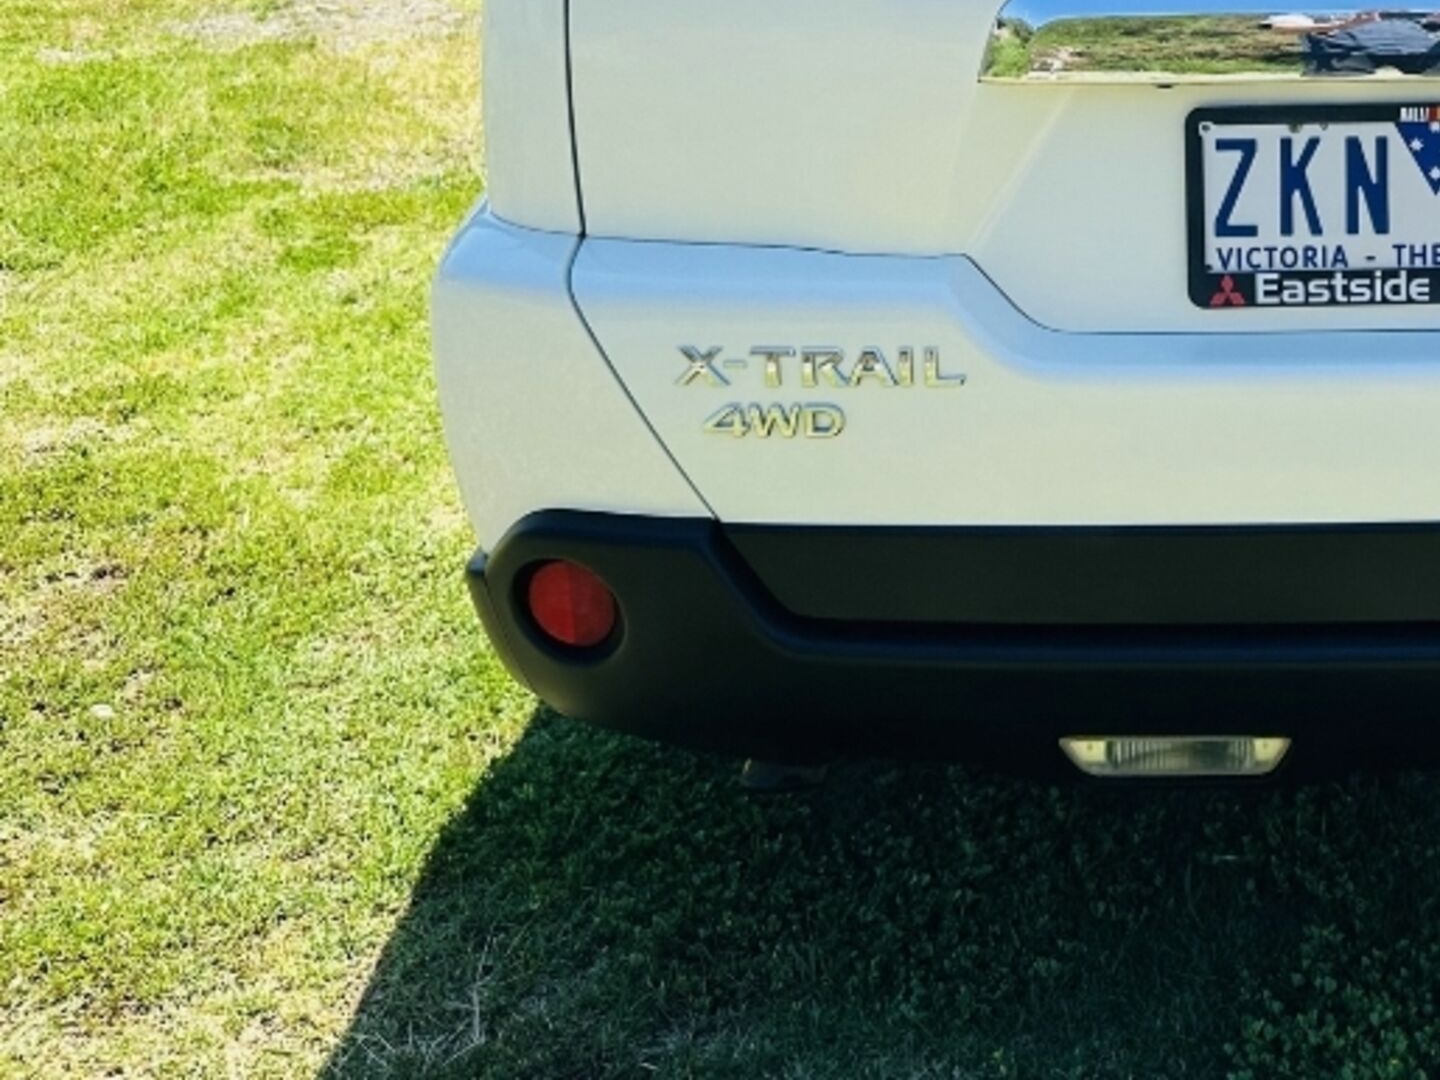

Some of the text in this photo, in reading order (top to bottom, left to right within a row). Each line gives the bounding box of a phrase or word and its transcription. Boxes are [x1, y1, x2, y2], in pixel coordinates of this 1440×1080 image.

[1214, 136, 1390, 238] ZKN
[1216, 245, 1349, 270] VICTORIA
[1255, 271, 1431, 304] Eastside
[675, 345, 967, 387] X-TRAIL
[703, 402, 847, 438] 4WD
